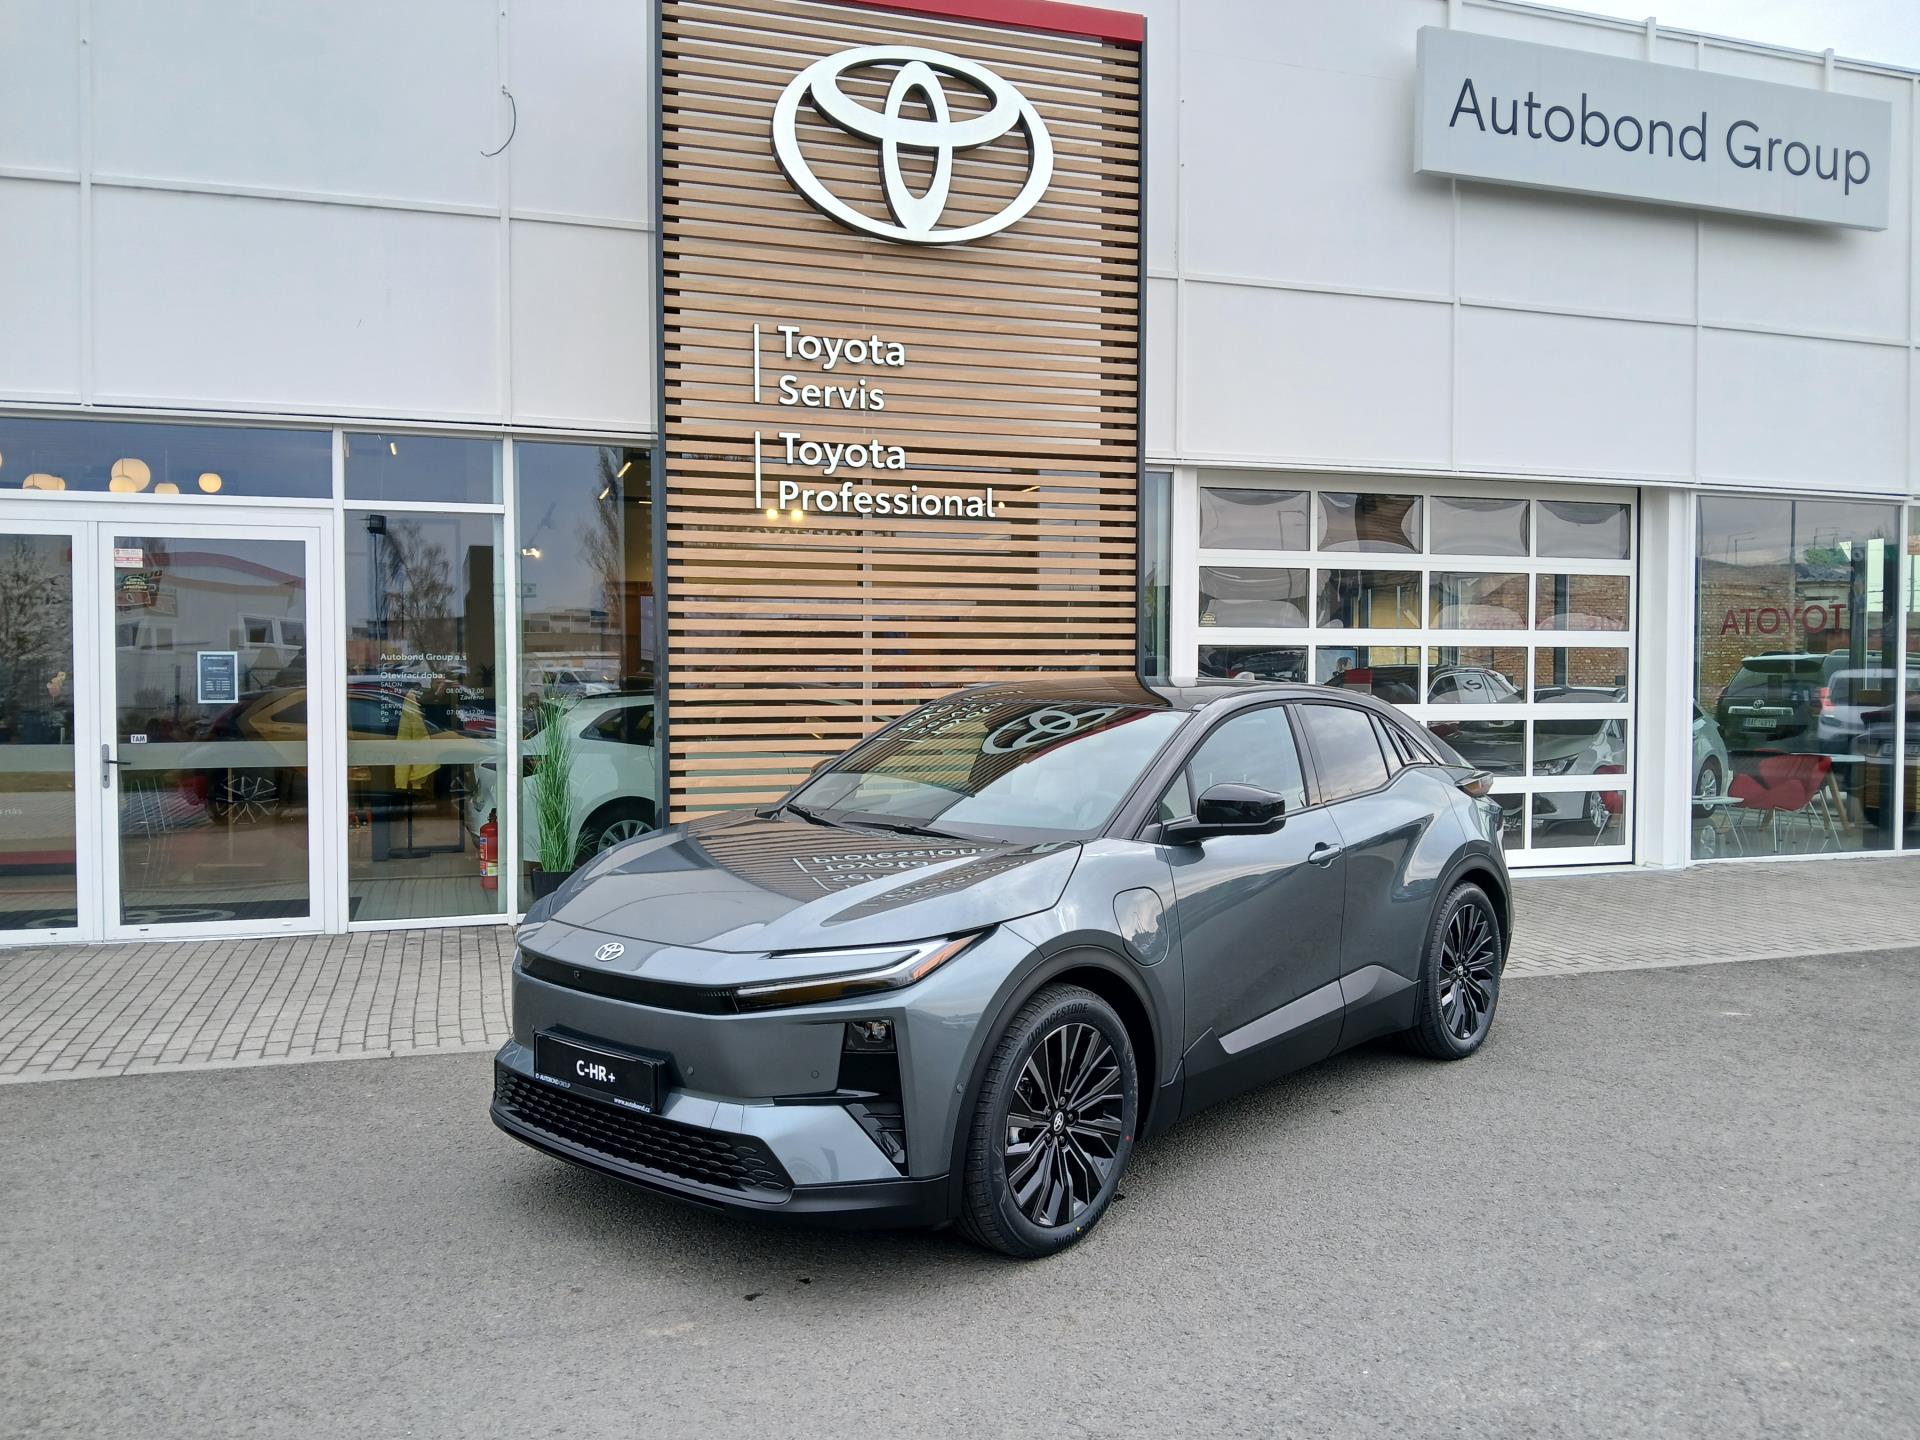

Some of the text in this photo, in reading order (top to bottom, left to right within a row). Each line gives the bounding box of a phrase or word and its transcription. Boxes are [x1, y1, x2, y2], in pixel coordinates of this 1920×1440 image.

[1448, 77, 1871, 196] Autobond Group
[777, 325, 906, 370] Toyota
[778, 374, 885, 411] Servis
[778, 432, 907, 475] Toyota
[778, 480, 996, 518] Professional
[380, 653, 424, 661] Autobond
[425, 653, 455, 662] Group
[420, 671, 446, 679] doba:
[576, 1059, 616, 1083] C-HR+
